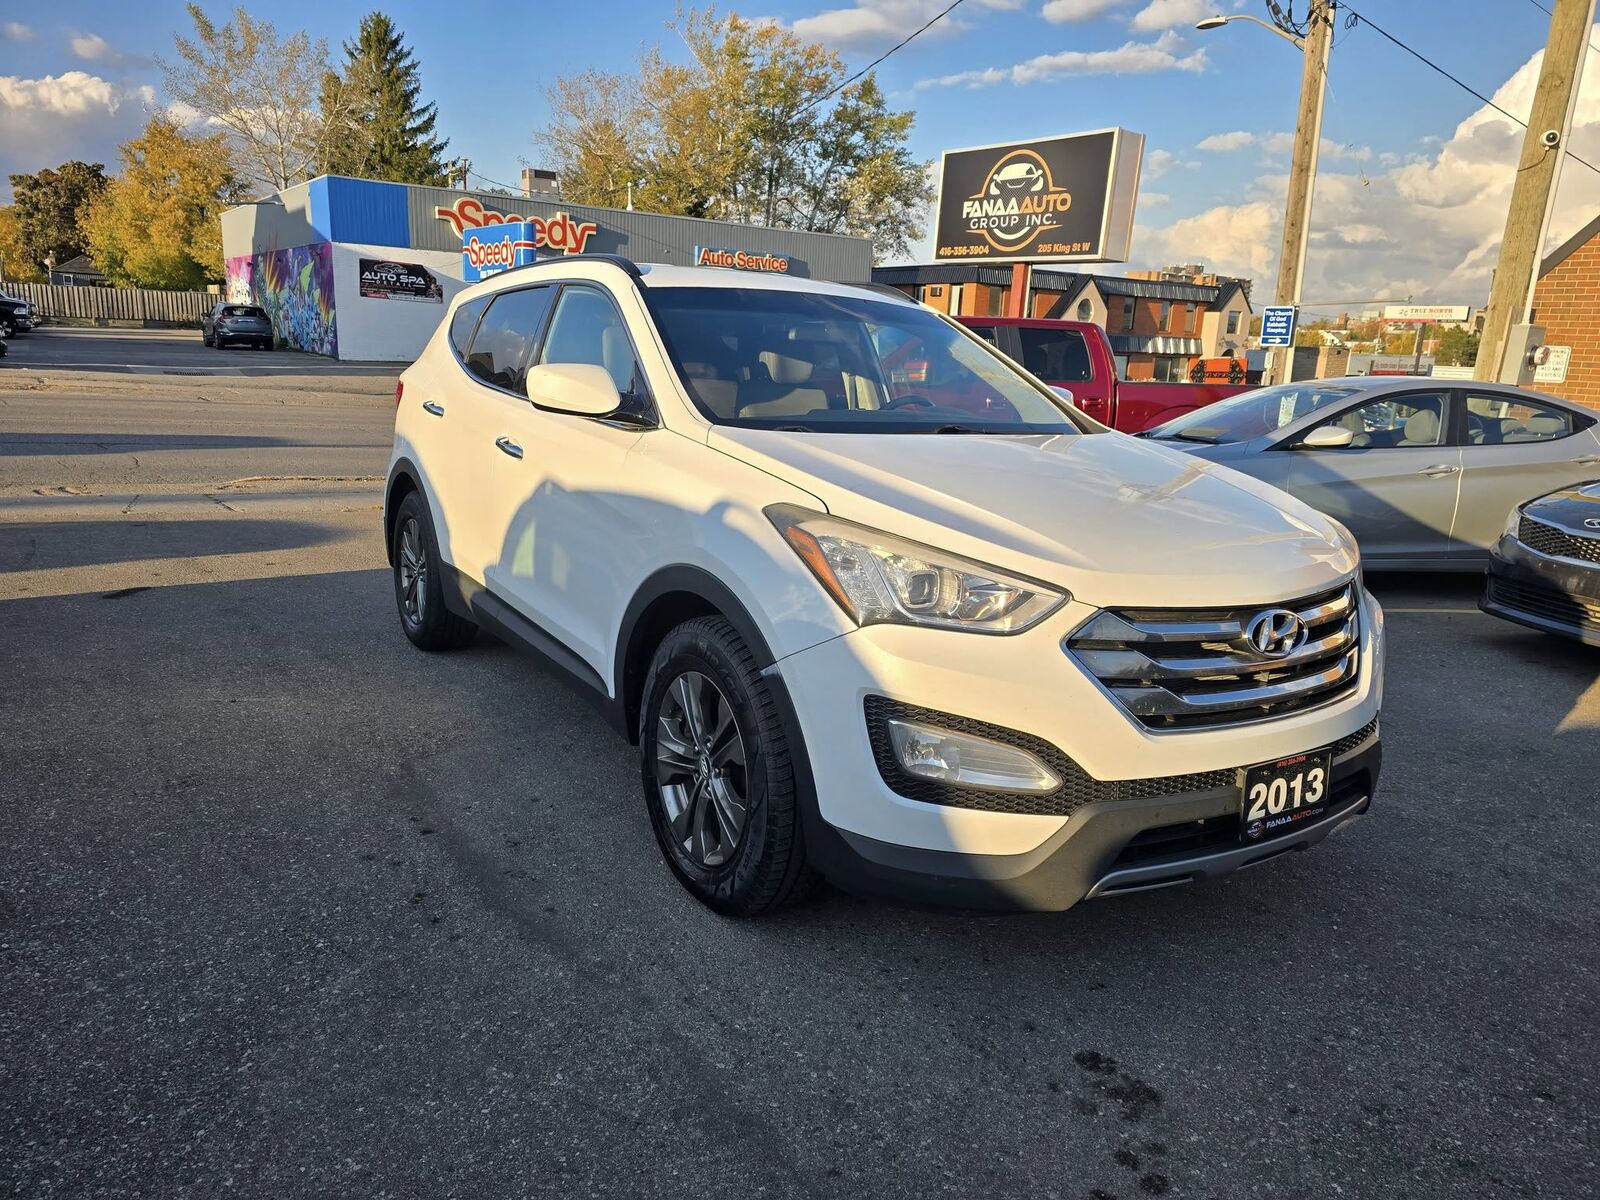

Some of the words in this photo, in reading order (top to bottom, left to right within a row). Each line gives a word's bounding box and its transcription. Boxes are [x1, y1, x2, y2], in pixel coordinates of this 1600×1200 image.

[969, 215, 1019, 229] GROUP
[1025, 213, 1057, 226] INC.
[465, 235, 520, 270] Speedy
[939, 244, 990, 256] 416-356-3904
[1037, 243, 1053, 253] 205
[1053, 243, 1071, 254] King
[1072, 242, 1081, 252] St
[1082, 241, 1091, 252] W
[698, 247, 735, 267] Auto
[735, 250, 788, 272] Service
[361, 271, 397, 281] AUTO
[399, 275, 426, 285] SPA
[376, 280, 412, 288] DETAIL
[1247, 767, 1324, 822] 2013
